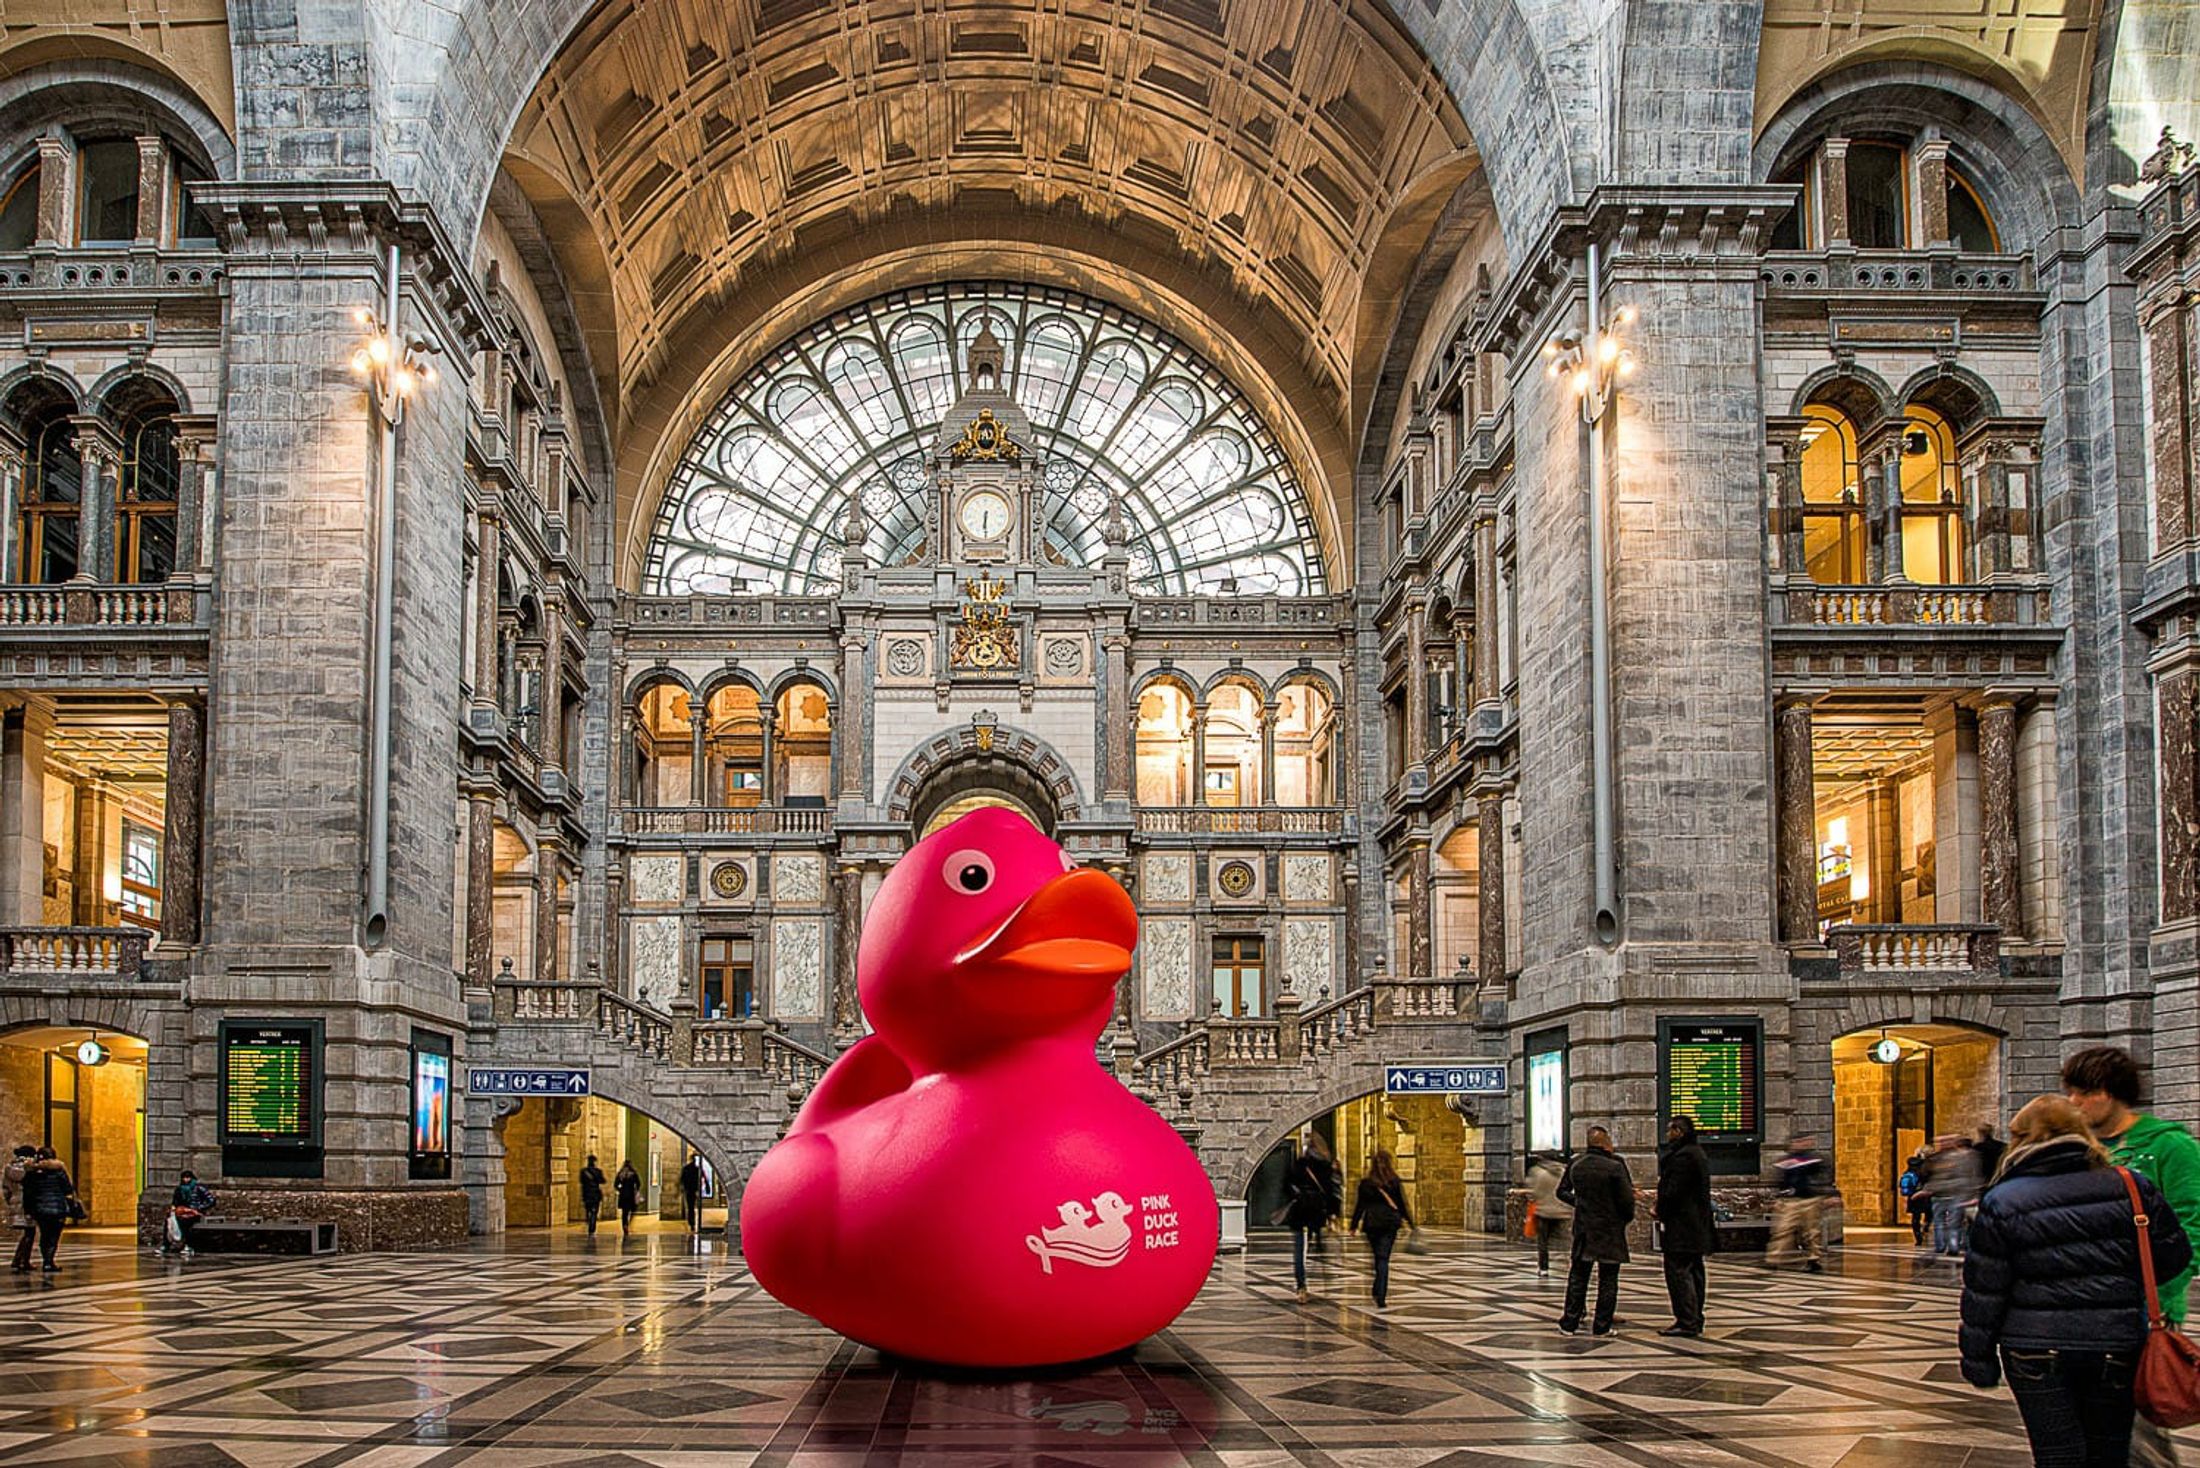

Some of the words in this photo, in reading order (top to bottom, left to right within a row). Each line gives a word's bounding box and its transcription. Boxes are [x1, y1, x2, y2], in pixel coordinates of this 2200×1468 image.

[1141, 1194, 1171, 1211] PINK
[1144, 1211, 1179, 1230] DUCK
[1145, 1231, 1179, 1249] RACE
